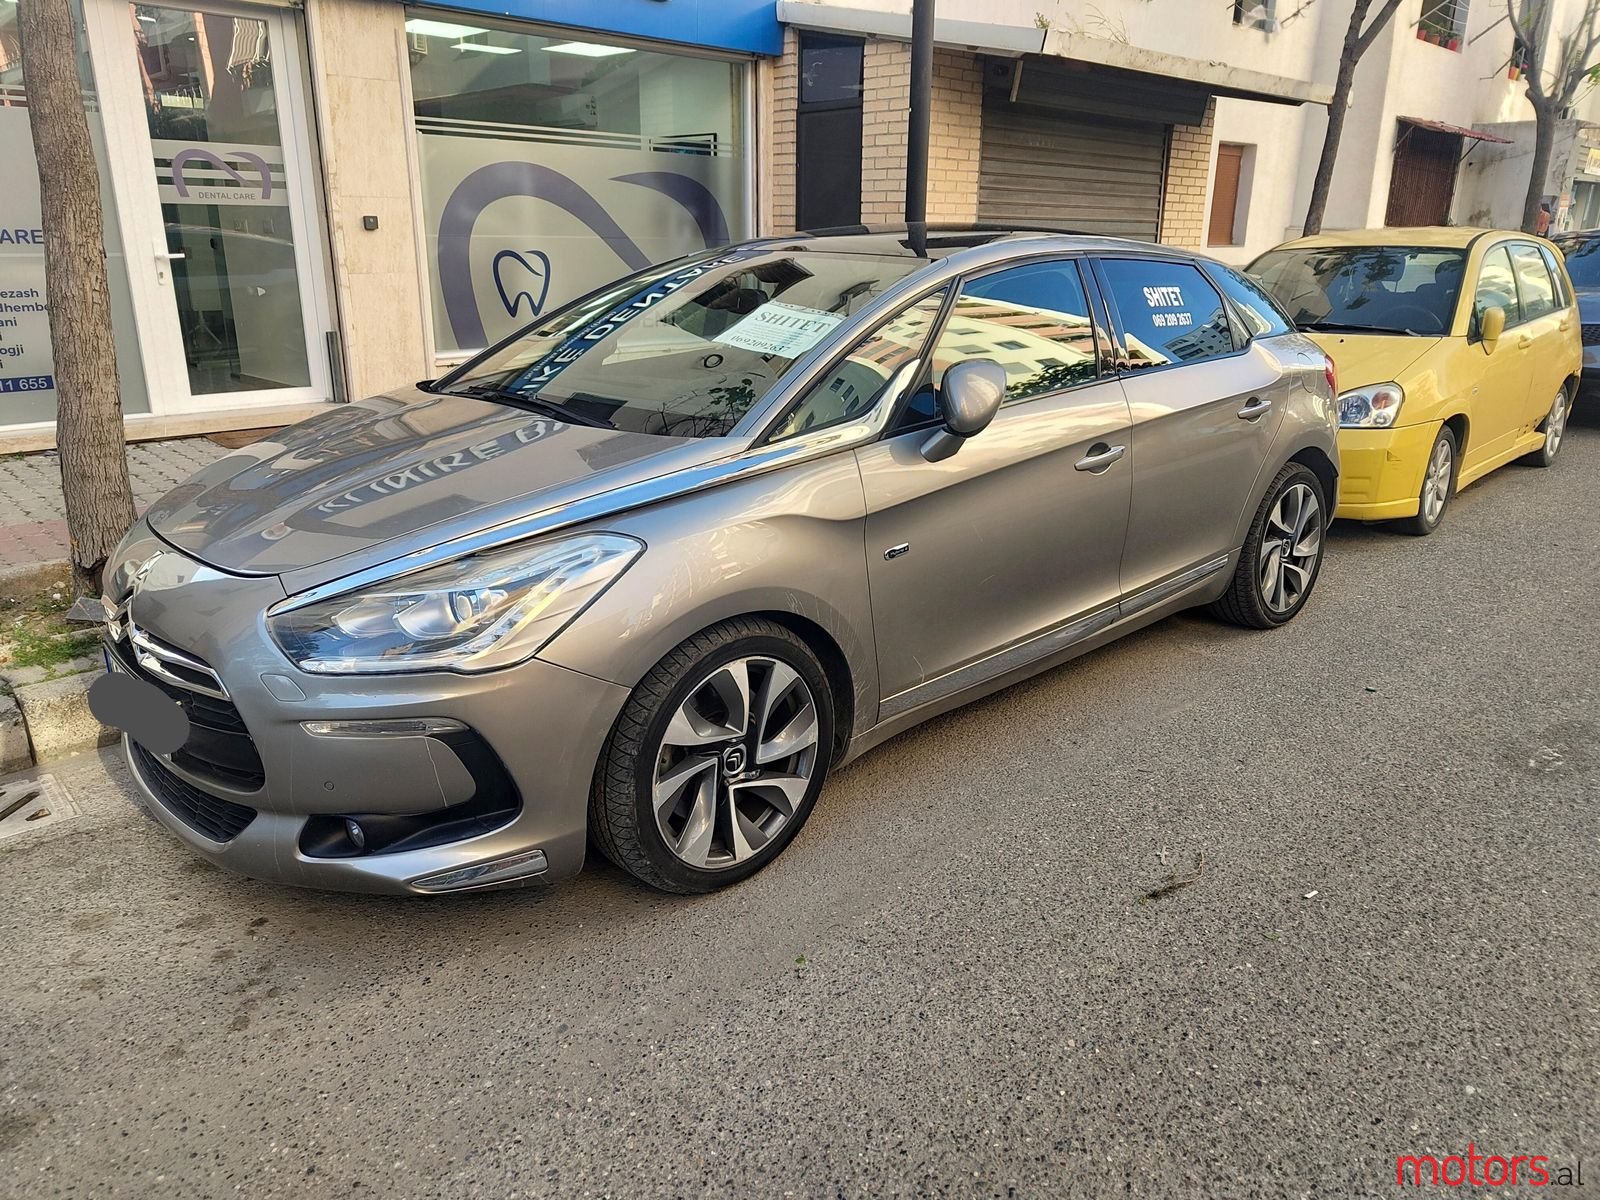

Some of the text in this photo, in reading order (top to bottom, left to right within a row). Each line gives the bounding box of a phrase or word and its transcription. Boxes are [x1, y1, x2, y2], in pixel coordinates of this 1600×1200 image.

[198, 191, 256, 200] DENTAL CARE
[1143, 286, 1184, 307] SHITET
[755, 311, 831, 332] SHITET
[1152, 312, 1193, 327] 069 209 2637
[19, 377, 48, 390] 655
